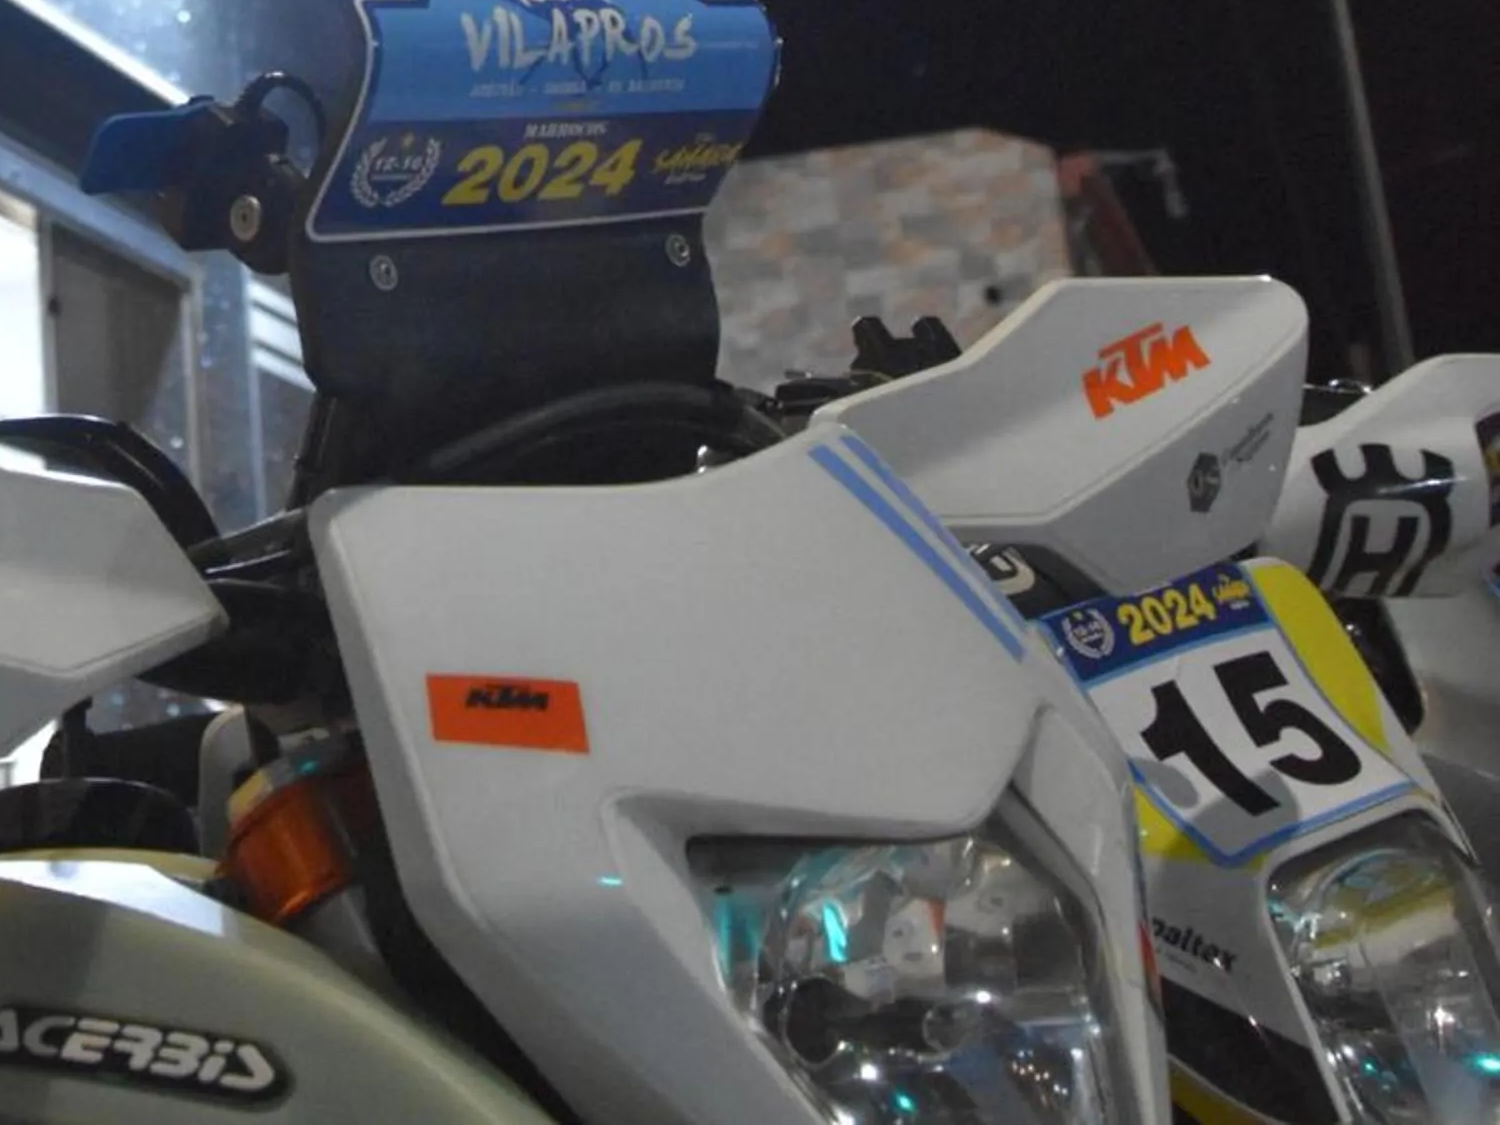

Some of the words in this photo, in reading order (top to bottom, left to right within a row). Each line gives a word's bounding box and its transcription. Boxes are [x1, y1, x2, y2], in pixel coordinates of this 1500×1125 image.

[441, 139, 643, 206] 2024
[1081, 322, 1212, 420] KTM
[1117, 582, 1217, 646] 2024
[465, 683, 550, 713] KTM
[1140, 650, 1363, 817] 15
